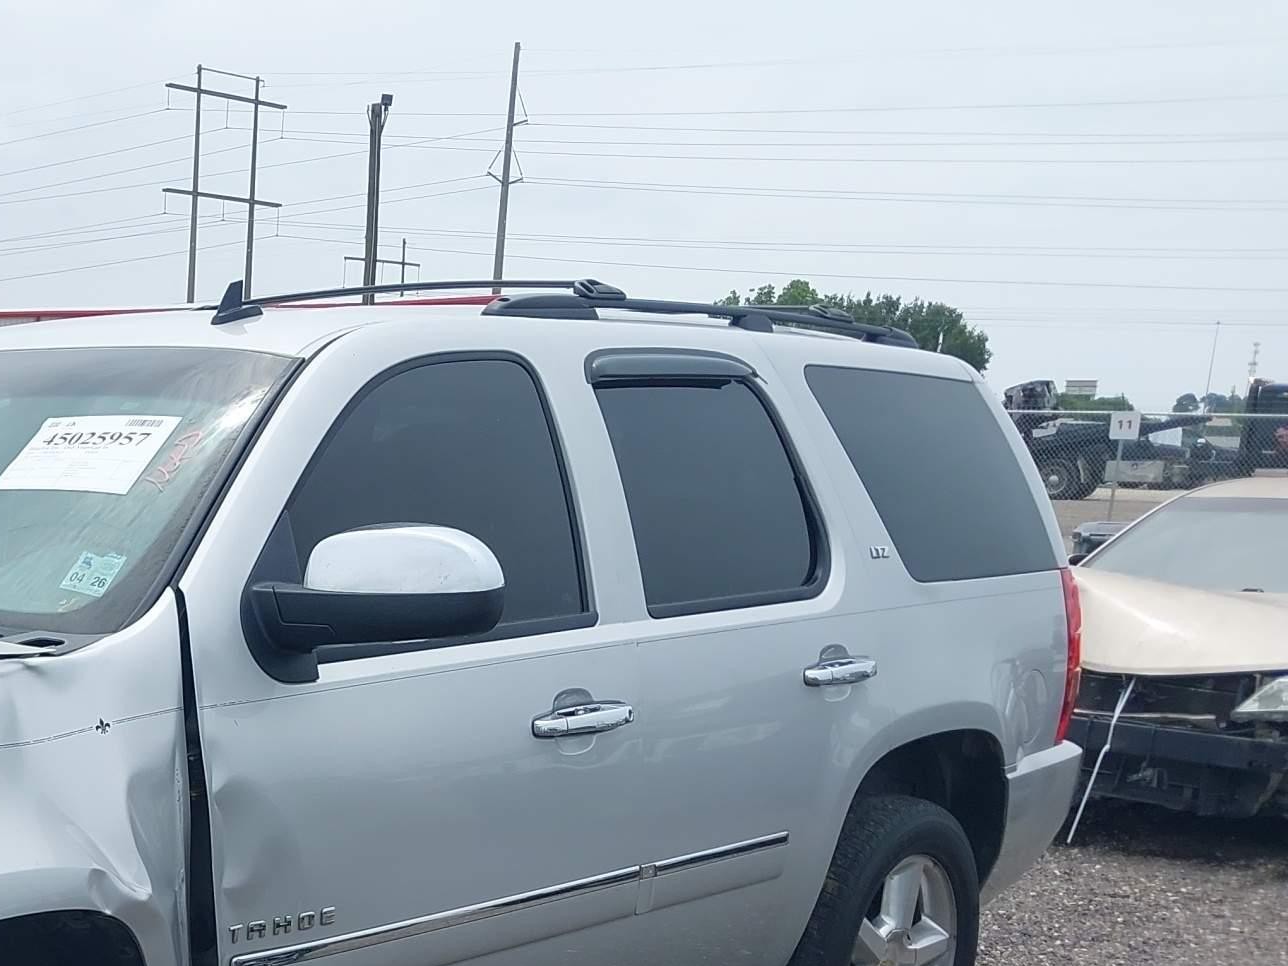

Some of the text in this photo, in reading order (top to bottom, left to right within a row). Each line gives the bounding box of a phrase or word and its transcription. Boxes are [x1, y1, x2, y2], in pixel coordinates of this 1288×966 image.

[1117, 419, 1133, 430] 11
[42, 431, 153, 447] 45025957
[69, 572, 108, 589] 04 26
[228, 906, 336, 944] TAHOE
